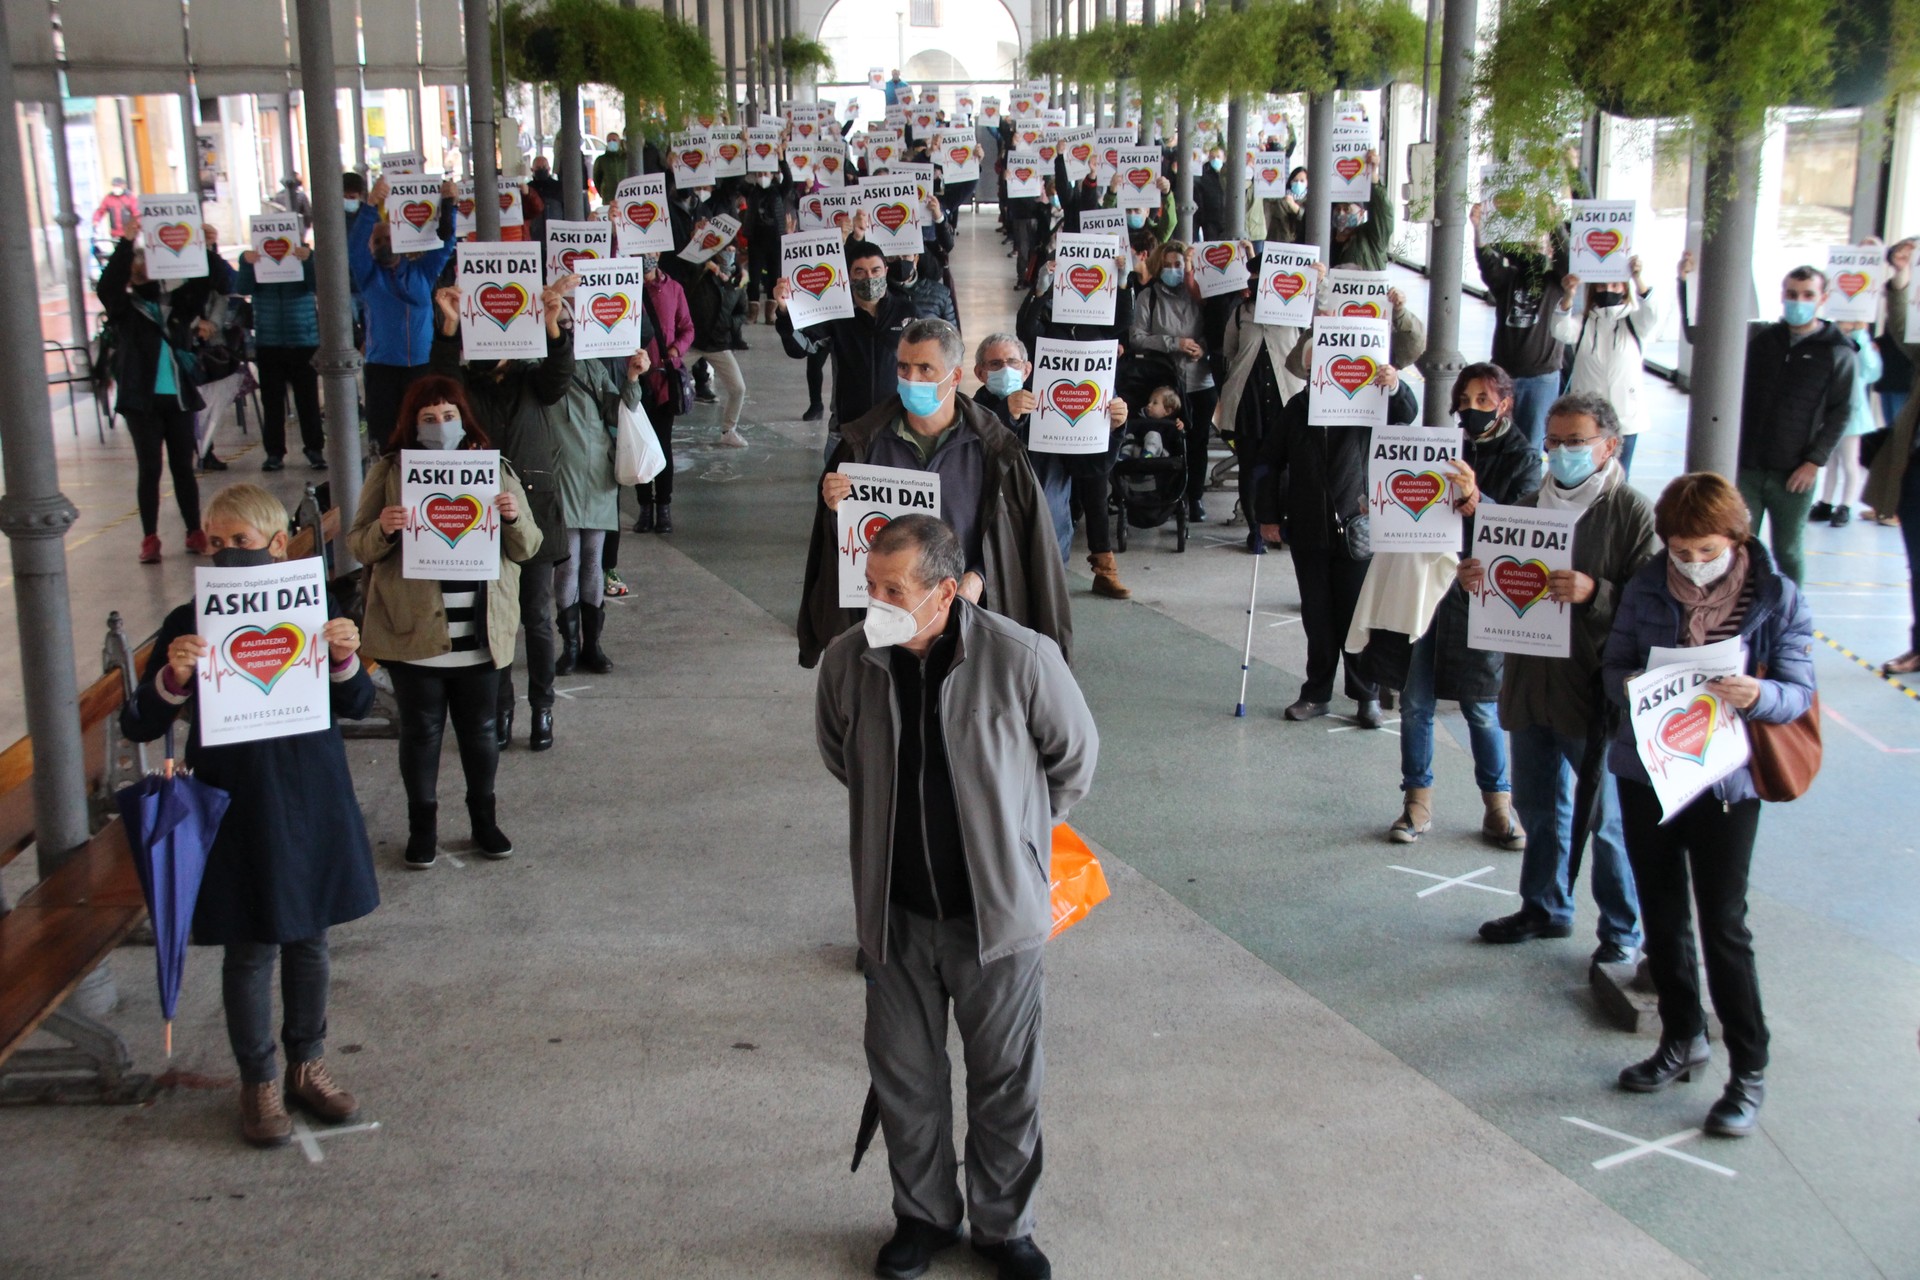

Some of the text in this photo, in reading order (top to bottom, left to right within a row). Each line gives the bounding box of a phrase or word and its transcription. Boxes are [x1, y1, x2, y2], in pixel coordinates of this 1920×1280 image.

[673, 137, 707, 147] ASKI DA!
[942, 134, 974, 144] ASKI DA!
[1063, 131, 1094, 143] ASKI DA!
[1098, 136, 1133, 144] ASKI DA!
[382, 158, 416, 169] ASKI DA!
[1119, 155, 1159, 164] ASKI DA!
[915, 172, 931, 181] DA!
[391, 185, 418, 196] ASKI
[618, 184, 663, 198] ASKI DA!
[863, 185, 914, 200] ASKI DA!
[823, 197, 846, 206] ASKI
[143, 205, 196, 216] ASKI DA!
[1575, 212, 1632, 222] ASKI DA!
[252, 222, 296, 233] ASKI DA!
[711, 217, 735, 236] SKI DA!
[1082, 218, 1124, 230] ASKI DA!
[550, 232, 607, 243] ASKI DA!
[784, 242, 840, 260] ASKI DA!
[1059, 246, 1116, 259] ASKI DA!
[1265, 254, 1292, 265] ASKI
[1829, 256, 1857, 265] ASKI
[462, 259, 537, 274] ASKI DA!
[579, 273, 639, 286] ASKI DA!
[1332, 283, 1389, 296] ASKI DA!
[1317, 333, 1385, 348] ASKI DA!
[1039, 355, 1112, 372] ASKI DA!
[1374, 444, 1456, 462] ASKI DA!
[407, 468, 494, 485] ASKI DA!
[843, 484, 935, 509] ASKI DA!
[1481, 514, 1507, 522] Asuncion
[1477, 525, 1568, 550] ASKI DA!
[1503, 569, 1538, 579] KALITATEZKO
[206, 573, 317, 589] Asuncion Ospitalea Konfinatua
[1500, 579, 1541, 588] OSASUNGINTZA
[1506, 588, 1534, 597] PUBLIKOA
[204, 584, 320, 615] ASKI DA!
[1484, 627, 1552, 640] MANIFESTAZIOA
[241, 636, 288, 648] KALITATEZKO
[236, 646, 292, 659] OSASUNGINTZA
[247, 659, 282, 669] PUBLIKOA
[1636, 677, 1684, 717] ASKI
[224, 705, 310, 723] MANIFESTAZIOA
[1668, 709, 1703, 731] KALITATEZKO
[1667, 717, 1708, 743] OSASUNGINTZA
[1678, 730, 1705, 749] PUBLIKOA
